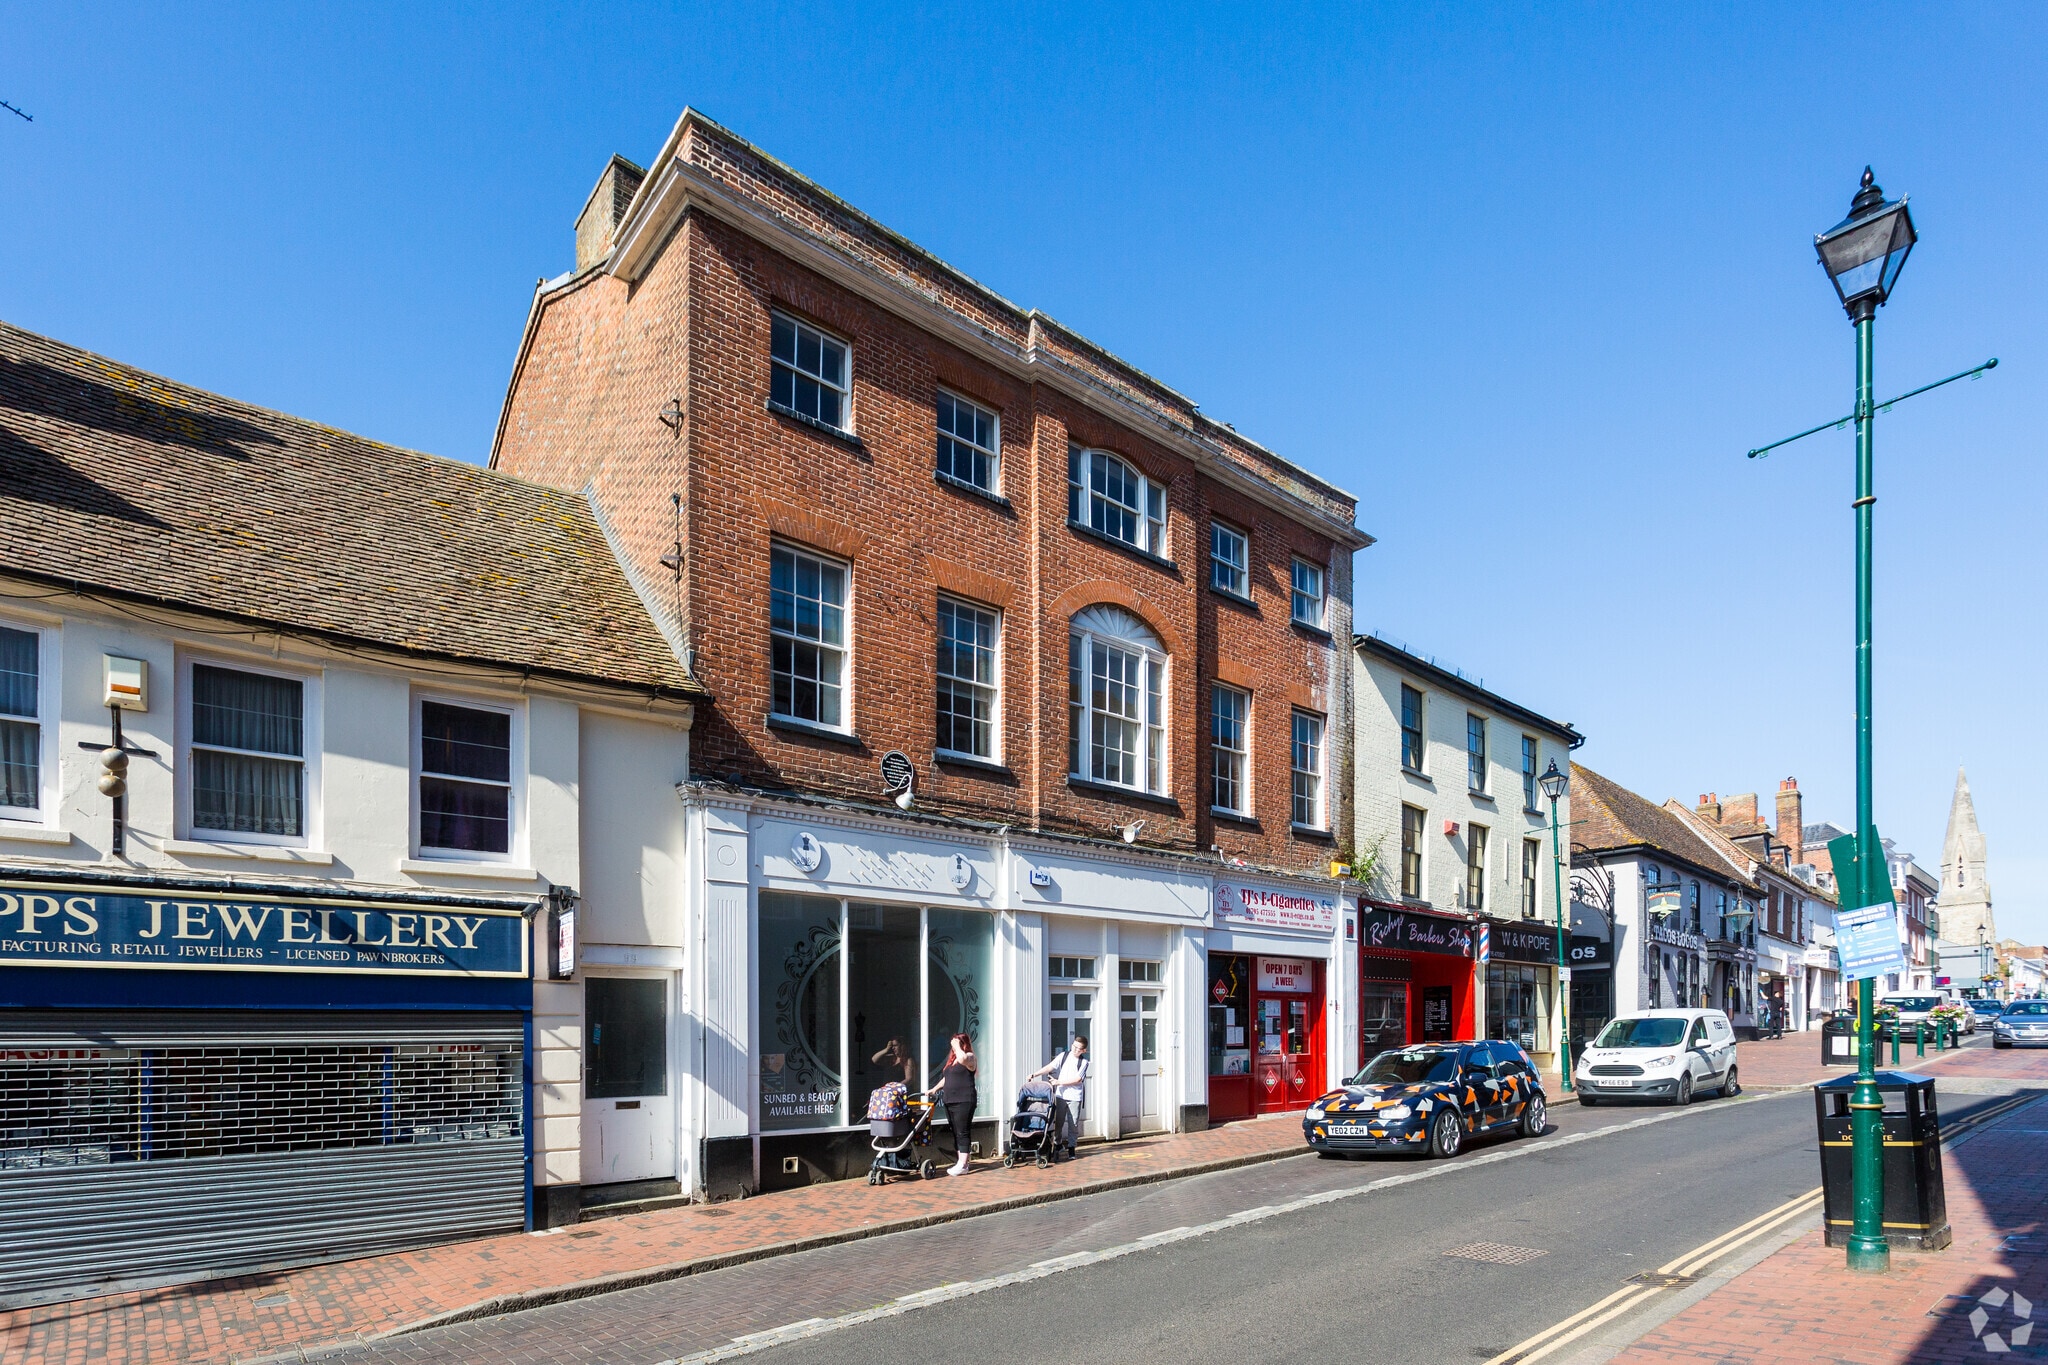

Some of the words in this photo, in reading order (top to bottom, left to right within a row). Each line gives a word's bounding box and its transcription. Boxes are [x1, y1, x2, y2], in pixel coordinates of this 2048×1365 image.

[1241, 889, 1259, 906] TJ's
[1261, 892, 1315, 911] E-Cigarettes
[138, 900, 489, 949] JEWELLERY
[1408, 922, 1446, 945] Barbers
[1653, 924, 1677, 945] TACOS
[1502, 931, 1512, 947] W
[1512, 934, 1519, 947] &
[1520, 934, 1527, 948] K
[1529, 935, 1551, 951] POPE
[1, 939, 102, 954] FACTURING
[111, 943, 170, 956] RETAIL
[178, 945, 263, 959] JEWELLERS
[286, 948, 351, 961] LICENSED
[357, 951, 446, 964] PAWNBROKERS
[1265, 963, 1283, 975] OPEN
[1289, 965, 1303, 976] DAYS
[1275, 976, 1280, 986] A
[1280, 977, 1295, 987] WEEK
[764, 1093, 797, 1104] SUNBED
[799, 1093, 806, 1102] &
[808, 1092, 838, 1102] BEAUTY
[769, 1105, 812, 1117] AVAILABLE
[814, 1104, 834, 1114] HERE
[1331, 1127, 1348, 1135] YE02
[1350, 1127, 1364, 1135] CZH
